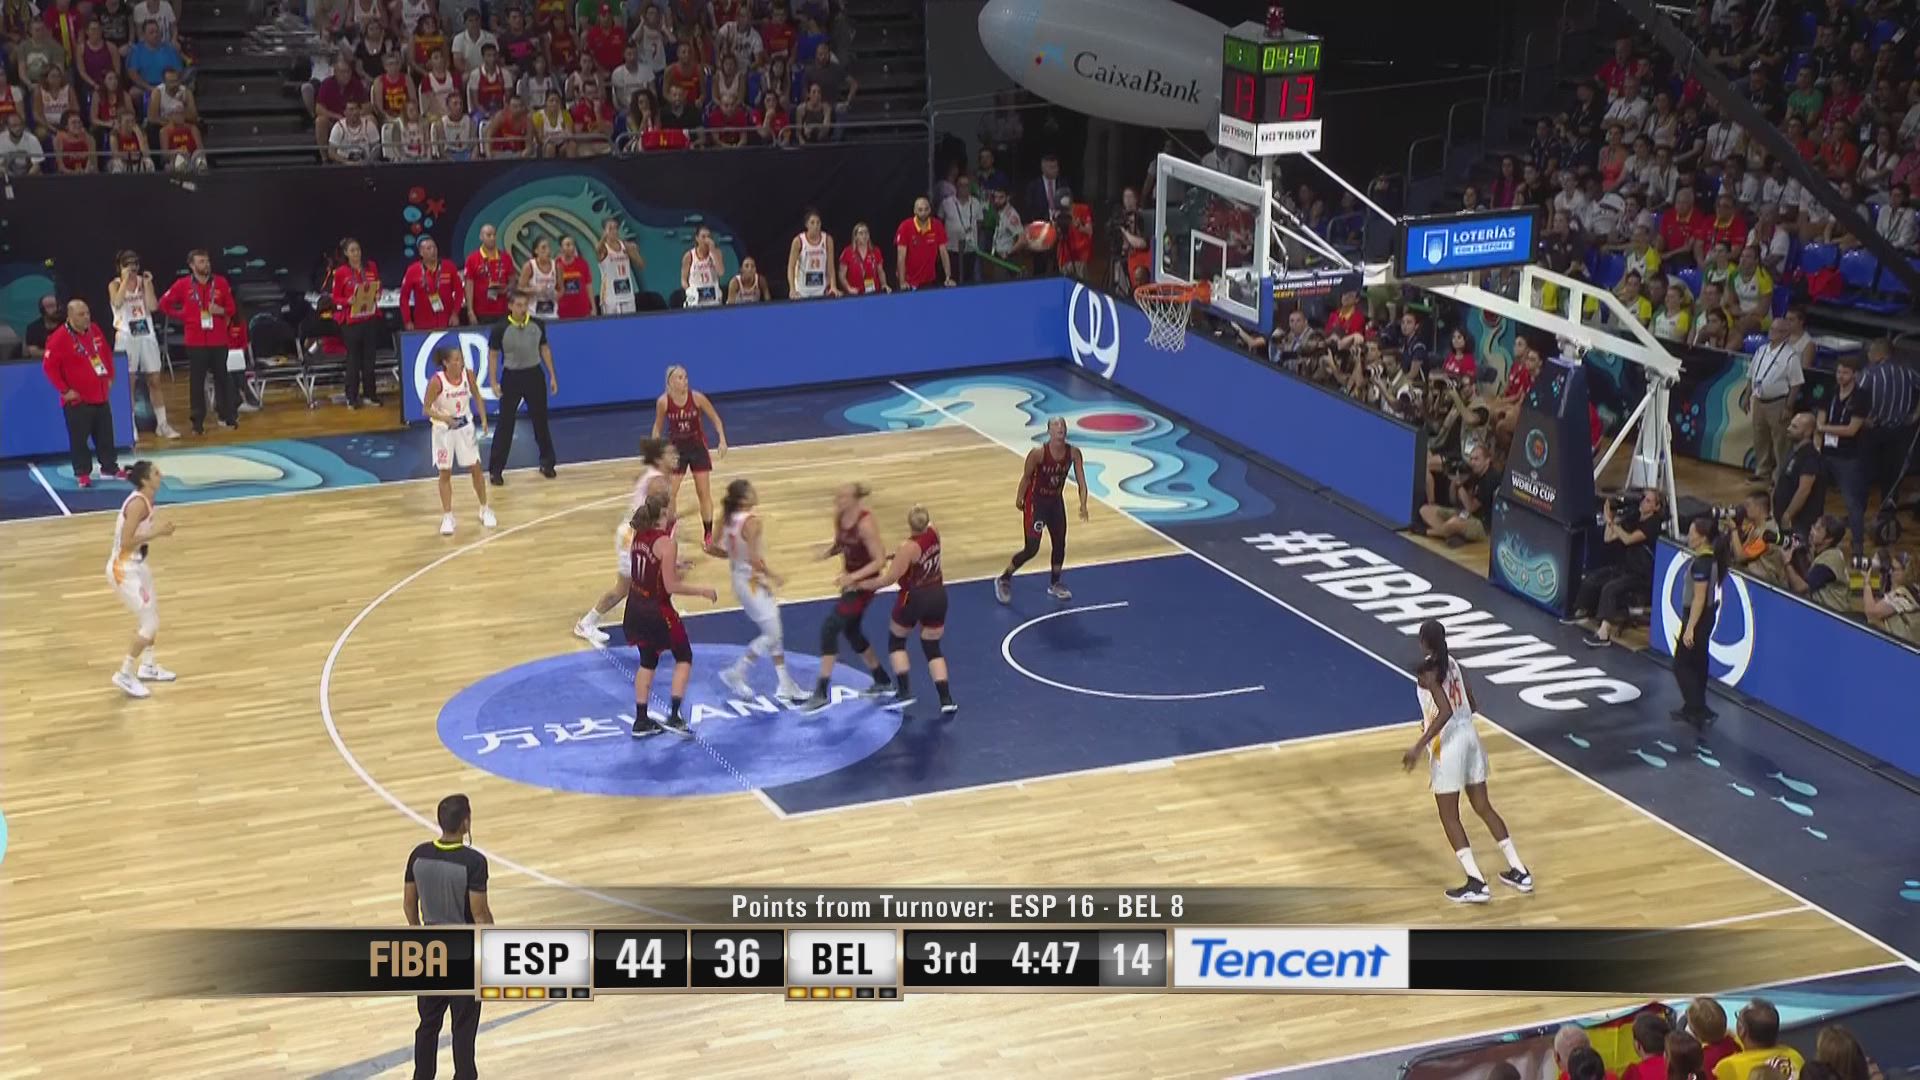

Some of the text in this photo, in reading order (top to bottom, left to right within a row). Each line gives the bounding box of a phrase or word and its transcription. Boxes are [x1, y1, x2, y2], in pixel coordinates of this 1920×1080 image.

[1263, 45, 1320, 70] 04:47
[1073, 51, 1202, 104] CaixaBank
[1279, 74, 1315, 121] 13
[1276, 128, 1317, 141] TISSOT
[1453, 225, 1516, 243] LOTERÍAS
[1511, 475, 1539, 497] WORLD
[1539, 488, 1556, 503] CUP
[1241, 530, 1642, 712] #FIBAWWC
[462, 716, 624, 755] 万达
